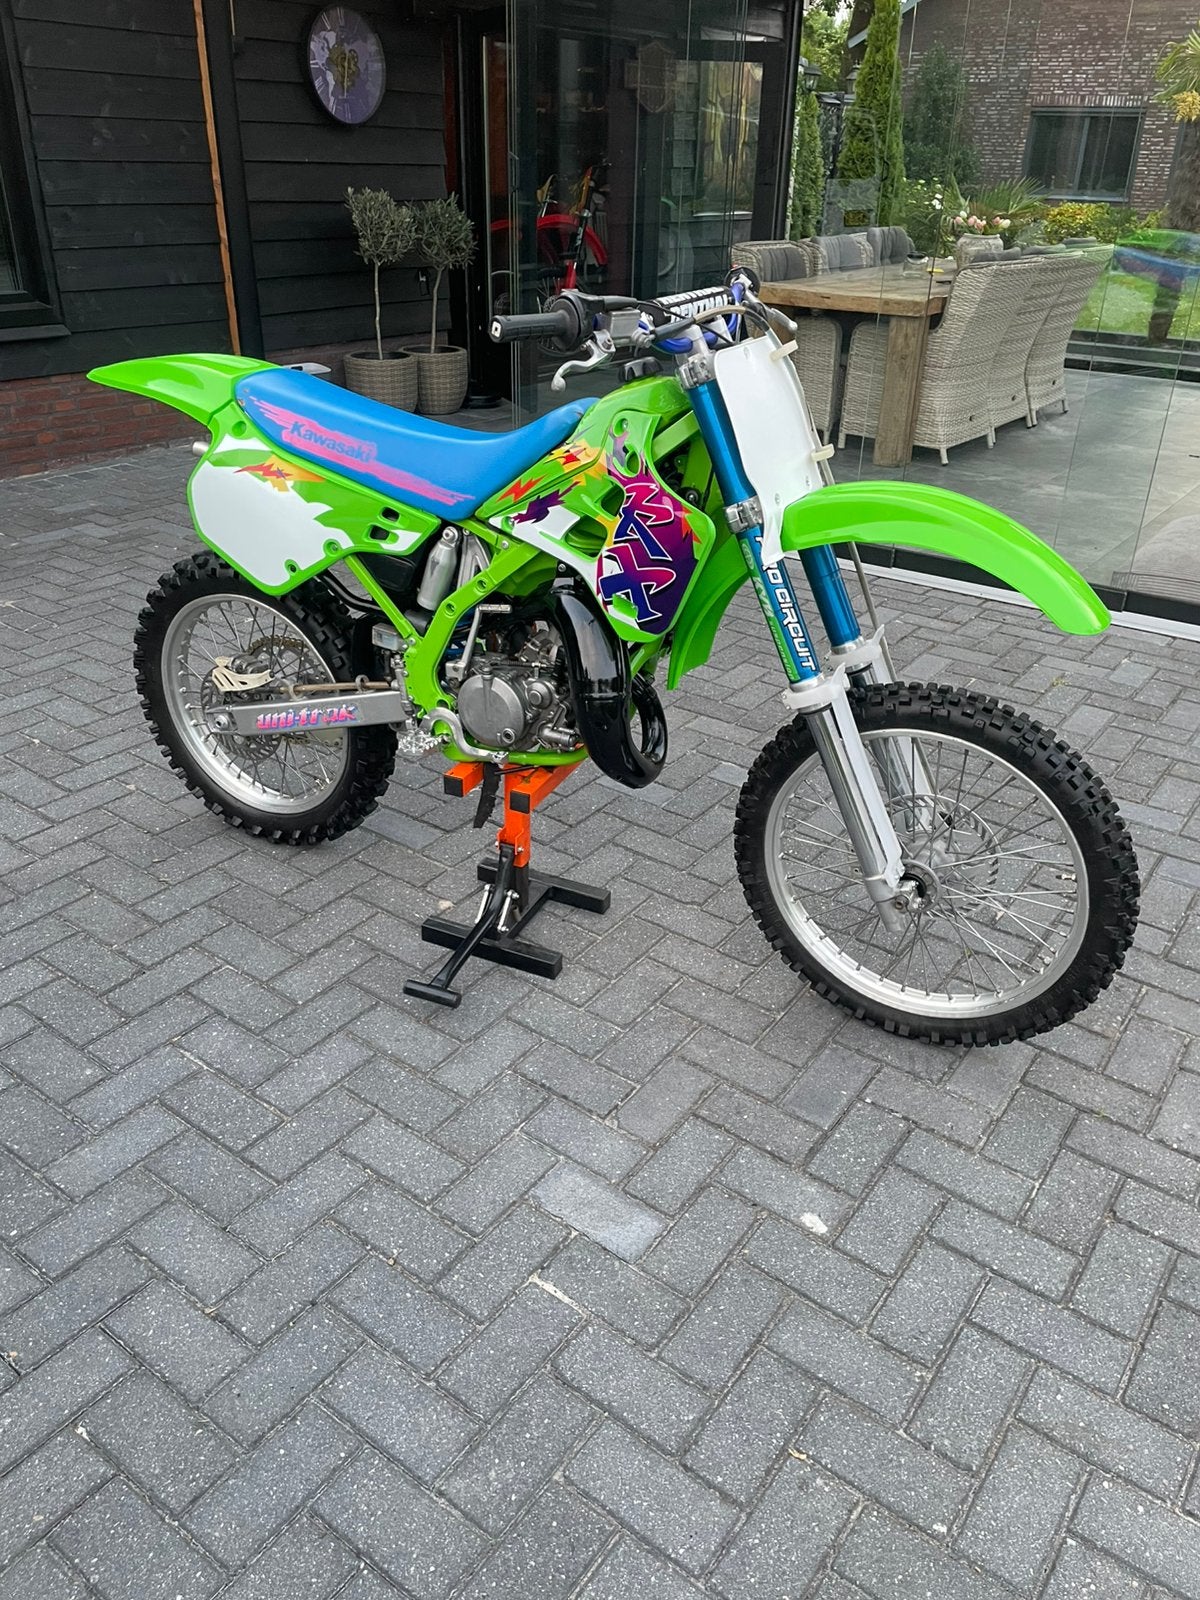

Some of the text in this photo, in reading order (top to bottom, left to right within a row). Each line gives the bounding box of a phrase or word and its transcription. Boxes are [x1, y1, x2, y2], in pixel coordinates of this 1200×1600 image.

[290, 421, 372, 462] Kawasaki
[598, 482, 676, 623] KX
[774, 588, 816, 671] CIRCUIT
